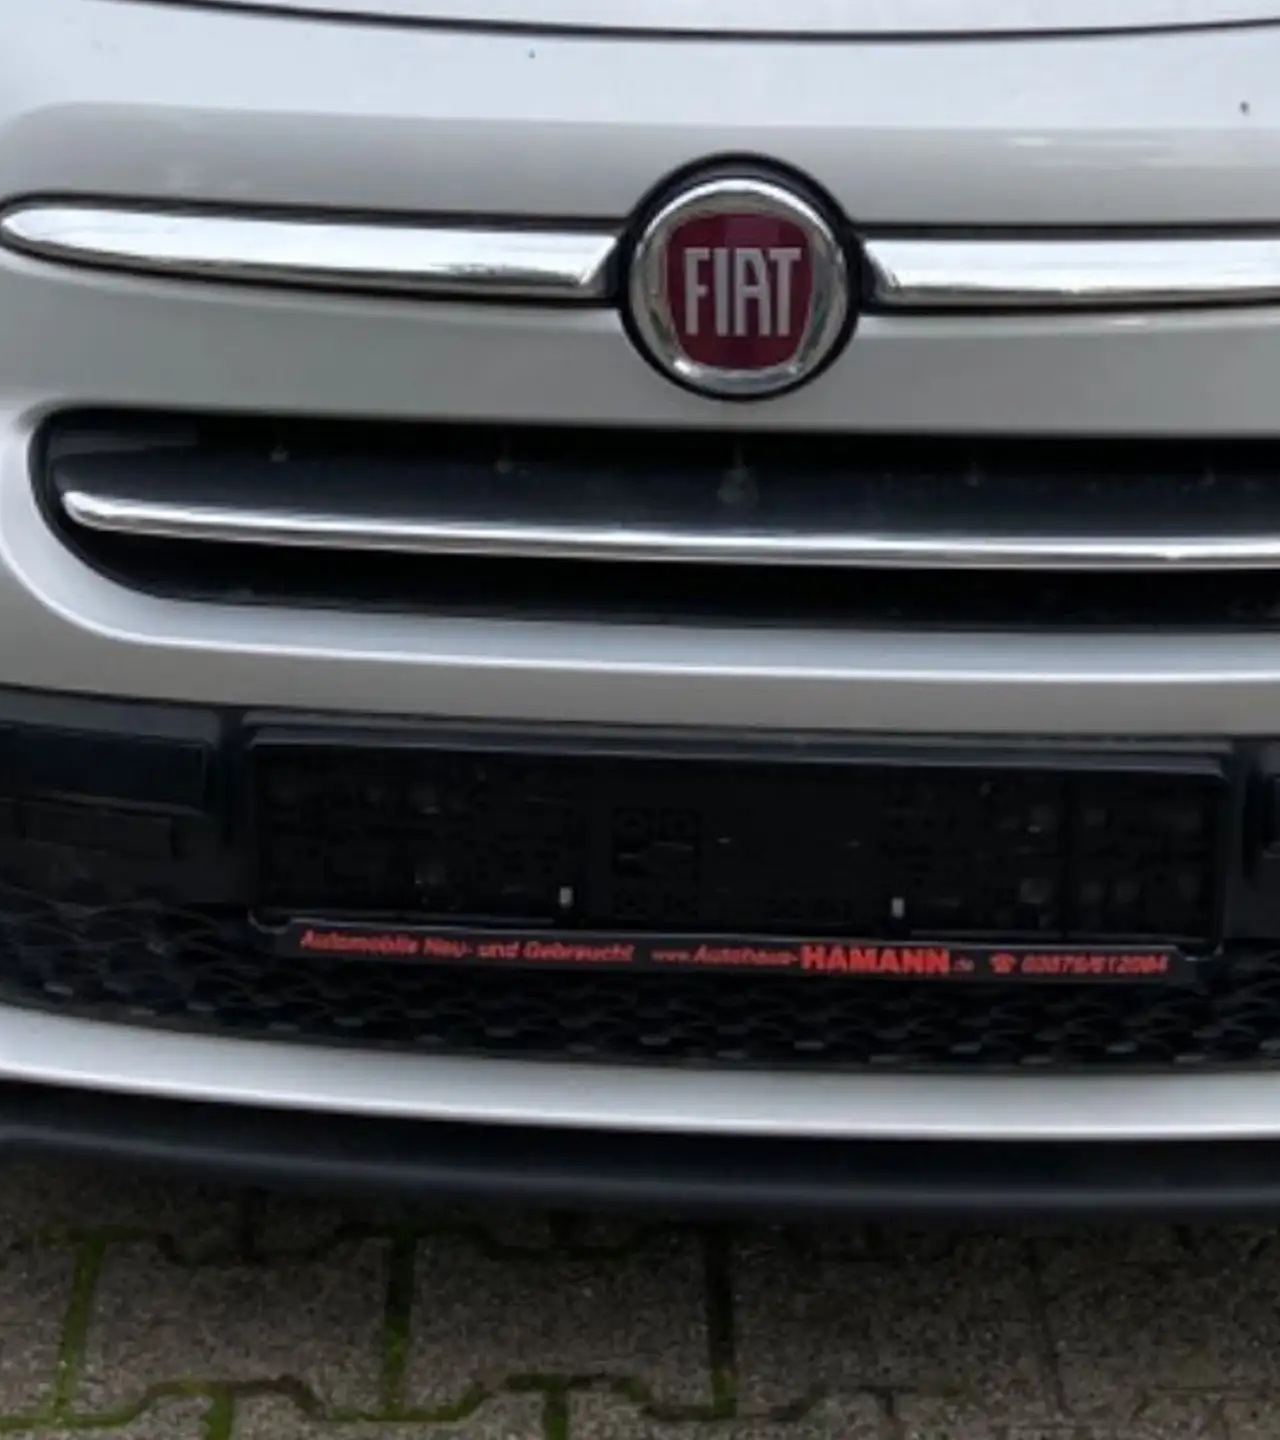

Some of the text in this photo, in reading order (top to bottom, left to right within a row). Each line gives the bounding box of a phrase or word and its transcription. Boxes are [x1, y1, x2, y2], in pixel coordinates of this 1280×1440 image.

[683, 246, 802, 337] FIAT
[300, 930, 418, 956] Automobile
[476, 941, 520, 960] und
